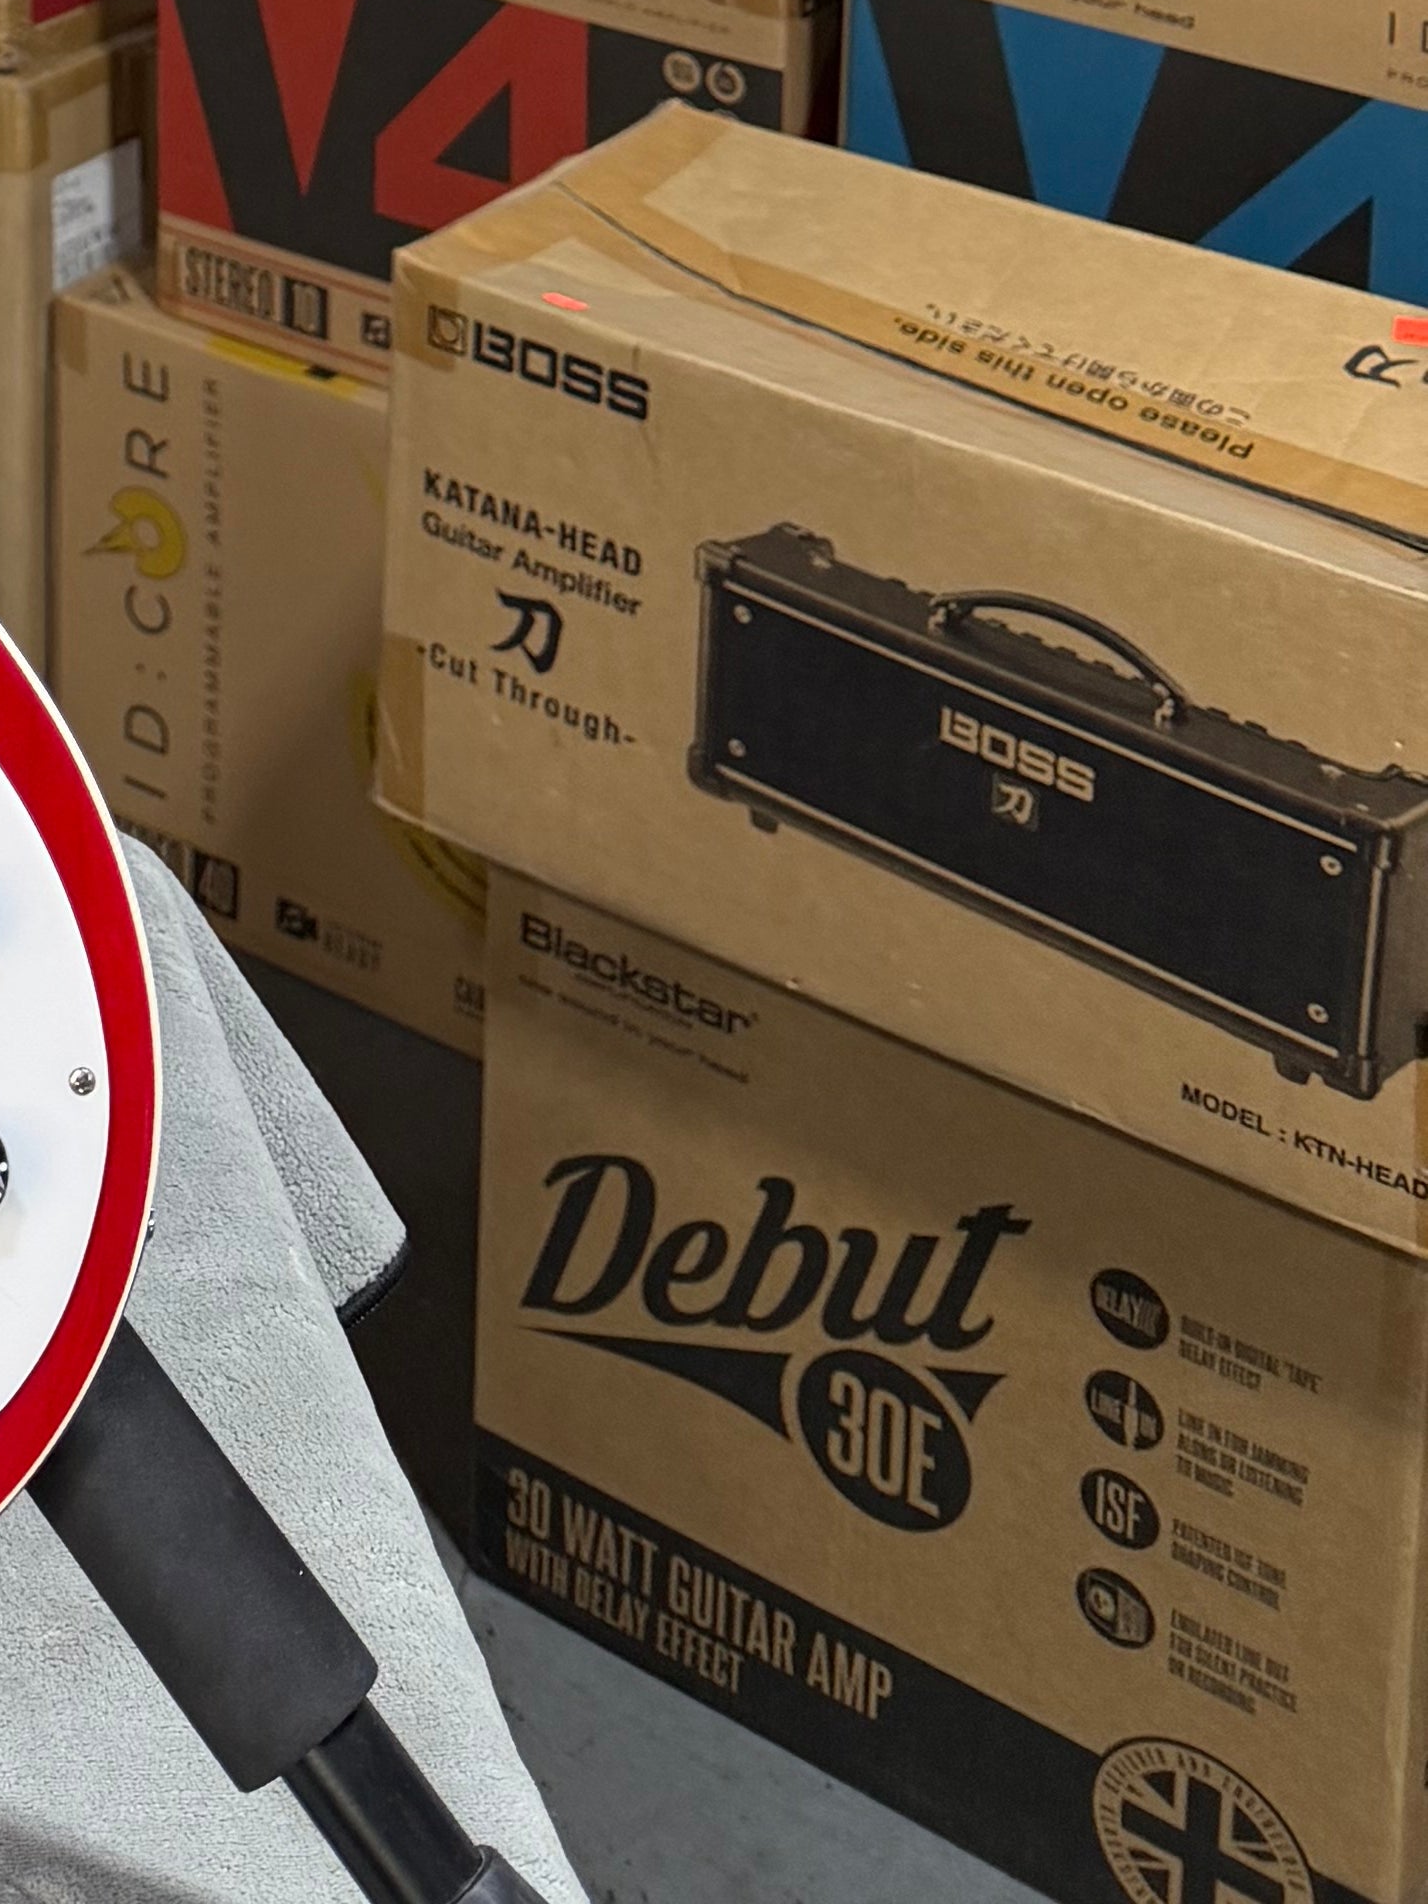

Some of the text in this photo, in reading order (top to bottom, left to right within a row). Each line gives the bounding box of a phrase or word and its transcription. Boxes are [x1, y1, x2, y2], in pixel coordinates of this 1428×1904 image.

[472, 319, 650, 420] BOSS
[976, 347, 1036, 383] this
[1046, 371, 1130, 413] open
[1138, 405, 1256, 462] Please
[420, 509, 643, 617] Guitar Amplifier
[423, 468, 643, 578] KATANA-HEAD
[491, 588, 564, 674] 刀
[939, 704, 1096, 803] BOSS
[519, 911, 752, 1035] Blackstar
[1181, 1081, 1271, 1138] MODEL
[1293, 1128, 1428, 1201] KTN-HEAD
[518, 1152, 1033, 1351] Debut
[824, 1367, 946, 1522] 30E
[1095, 1474, 1145, 1540] ISF
[504, 1528, 746, 1694] WITH DELAY EFFECT
[505, 1467, 893, 1721] 30 WATT GUITAR AMP
